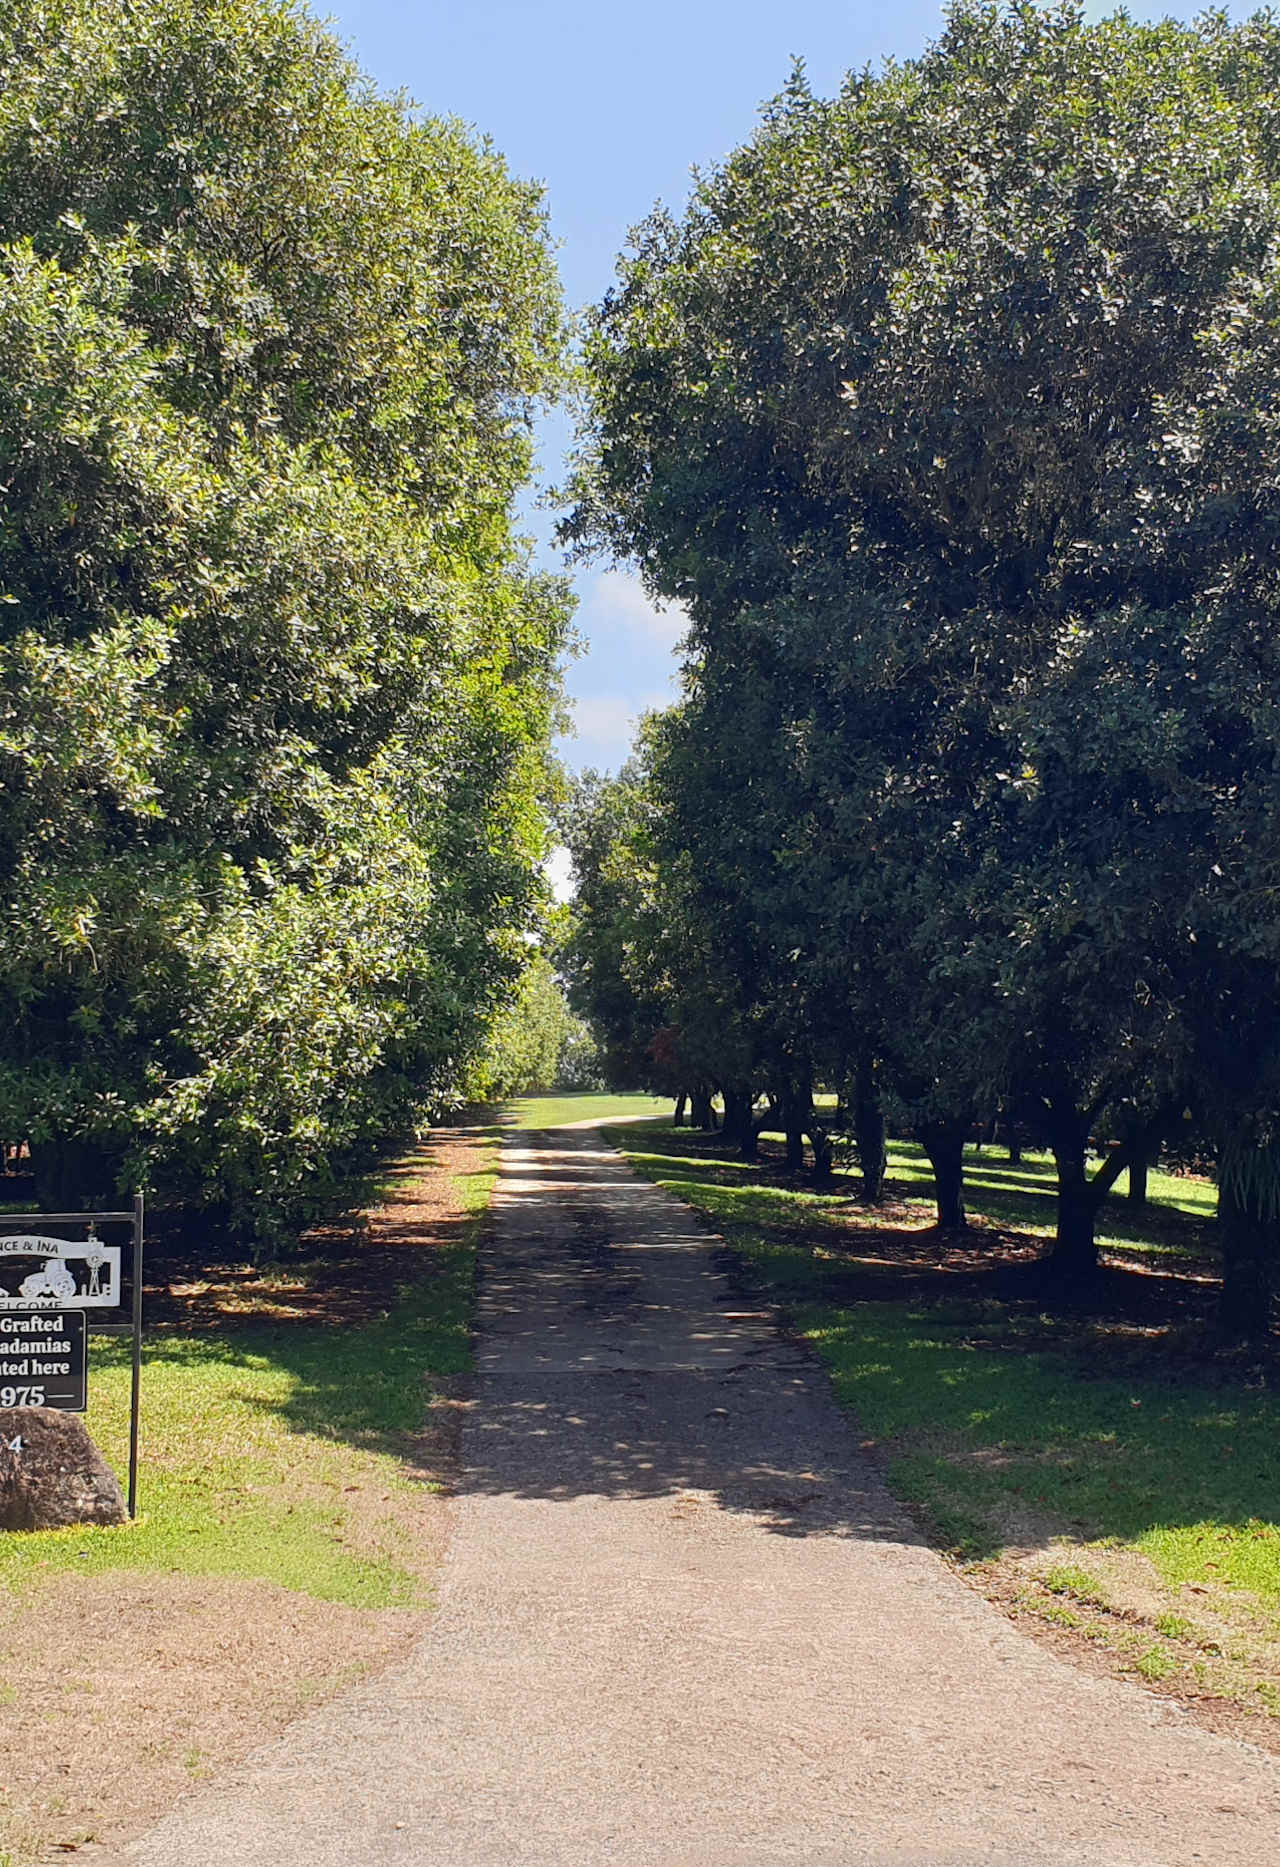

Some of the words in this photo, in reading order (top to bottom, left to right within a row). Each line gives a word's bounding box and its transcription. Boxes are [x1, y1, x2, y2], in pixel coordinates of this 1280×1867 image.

[22, 1240, 33, 1251] &
[37, 1240, 59, 1254] INA
[0, 1315, 63, 1333] Grafted
[32, 1359, 70, 1376] here
